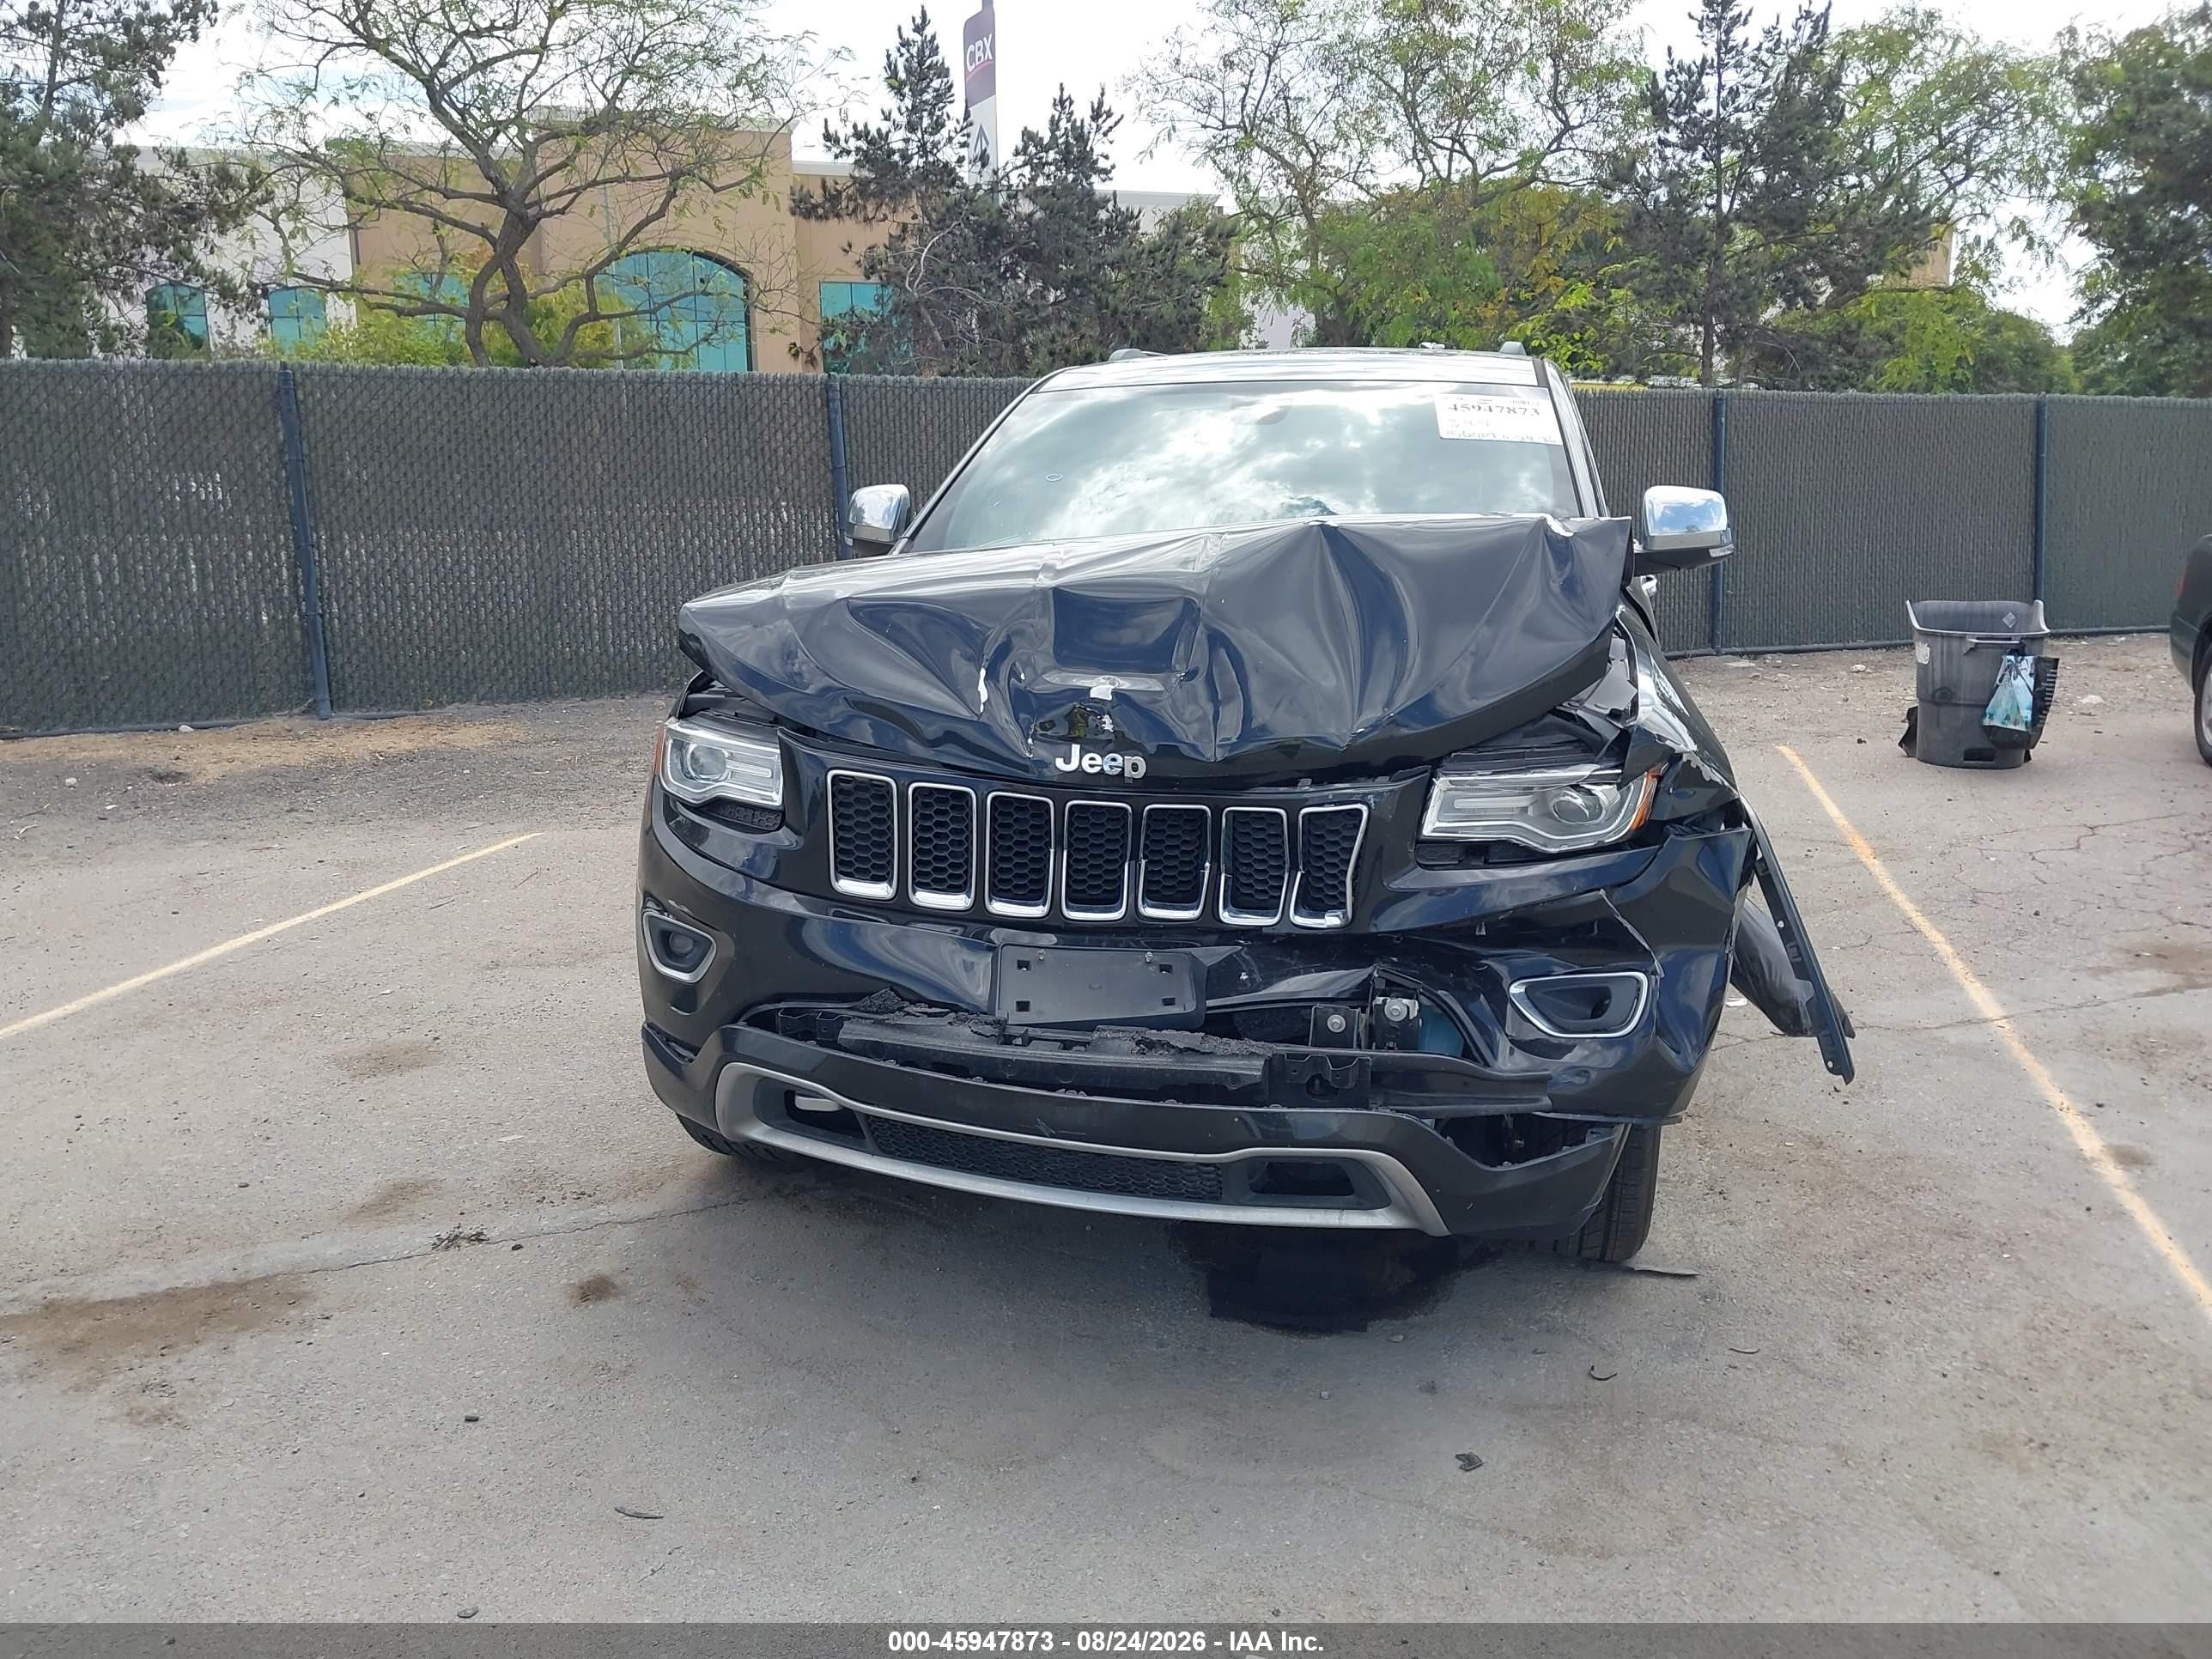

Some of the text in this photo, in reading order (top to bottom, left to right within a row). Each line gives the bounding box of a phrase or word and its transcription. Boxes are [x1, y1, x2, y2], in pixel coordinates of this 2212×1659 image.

[967, 33, 993, 72] CBX
[1449, 404, 1540, 416] 45947873
[1055, 744, 1146, 783] Jeep
